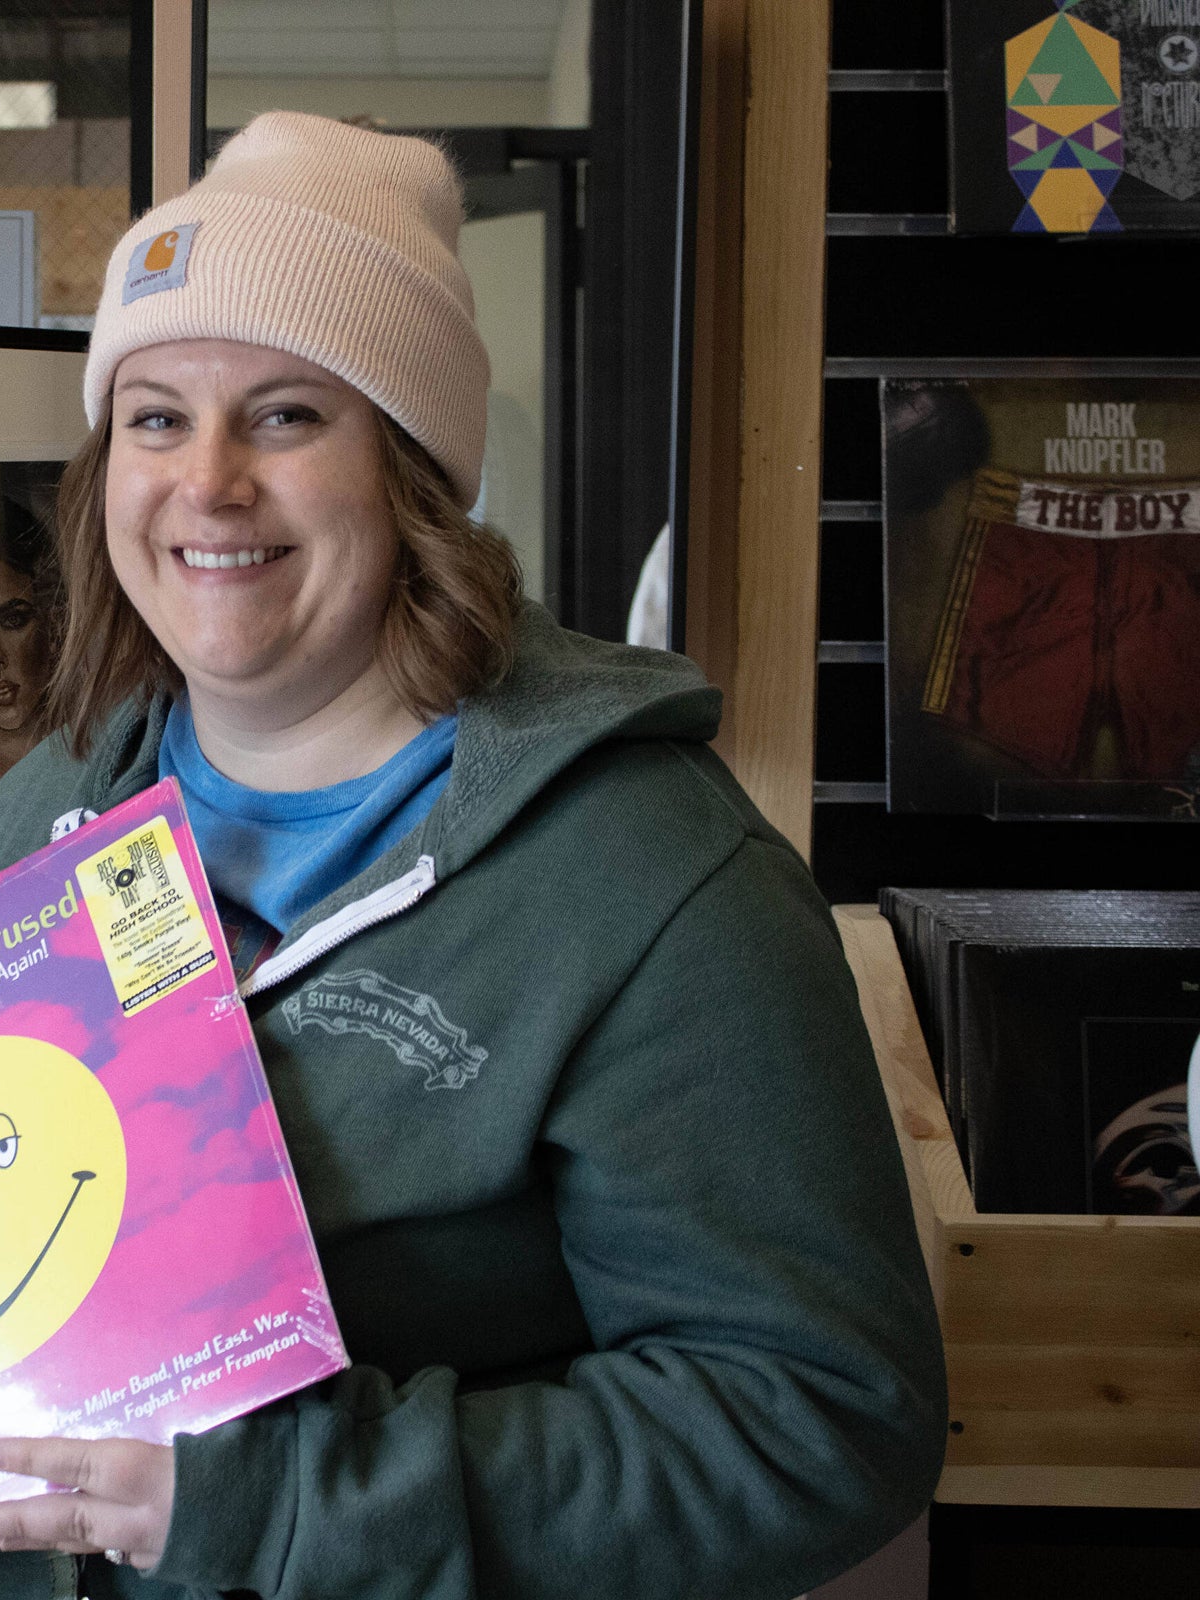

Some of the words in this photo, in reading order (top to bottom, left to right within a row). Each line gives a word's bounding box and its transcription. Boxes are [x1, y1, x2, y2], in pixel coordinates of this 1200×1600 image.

[1066, 402, 1137, 437] MARK
[1044, 438, 1166, 474] KNOPFLER
[1032, 489, 1103, 531] THE
[1115, 492, 1191, 532] BOY
[141, 834, 168, 888] EXCLUSIVE
[110, 920, 136, 940] HIGH
[138, 894, 184, 921] SCHOOL
[111, 917, 127, 930] GO
[129, 898, 160, 919] BACK
[162, 888, 176, 900] TO
[120, 882, 140, 909] DAY
[154, 925, 175, 940] Purple
[176, 914, 192, 927] Vinyl
[124, 984, 158, 1010] LISTEN
[156, 971, 182, 991] WITH
[180, 966, 190, 977] A
[306, 990, 380, 1018] SIERRA
[381, 1008, 450, 1061] NEVADA
[84, 1386, 126, 1416] Miller
[128, 1362, 173, 1397] Band,
[172, 1342, 212, 1376] Head
[212, 1328, 254, 1356] East,
[124, 1388, 180, 1424] Foghat,
[180, 1366, 224, 1396] Peter
[224, 1332, 300, 1376] Frampton
